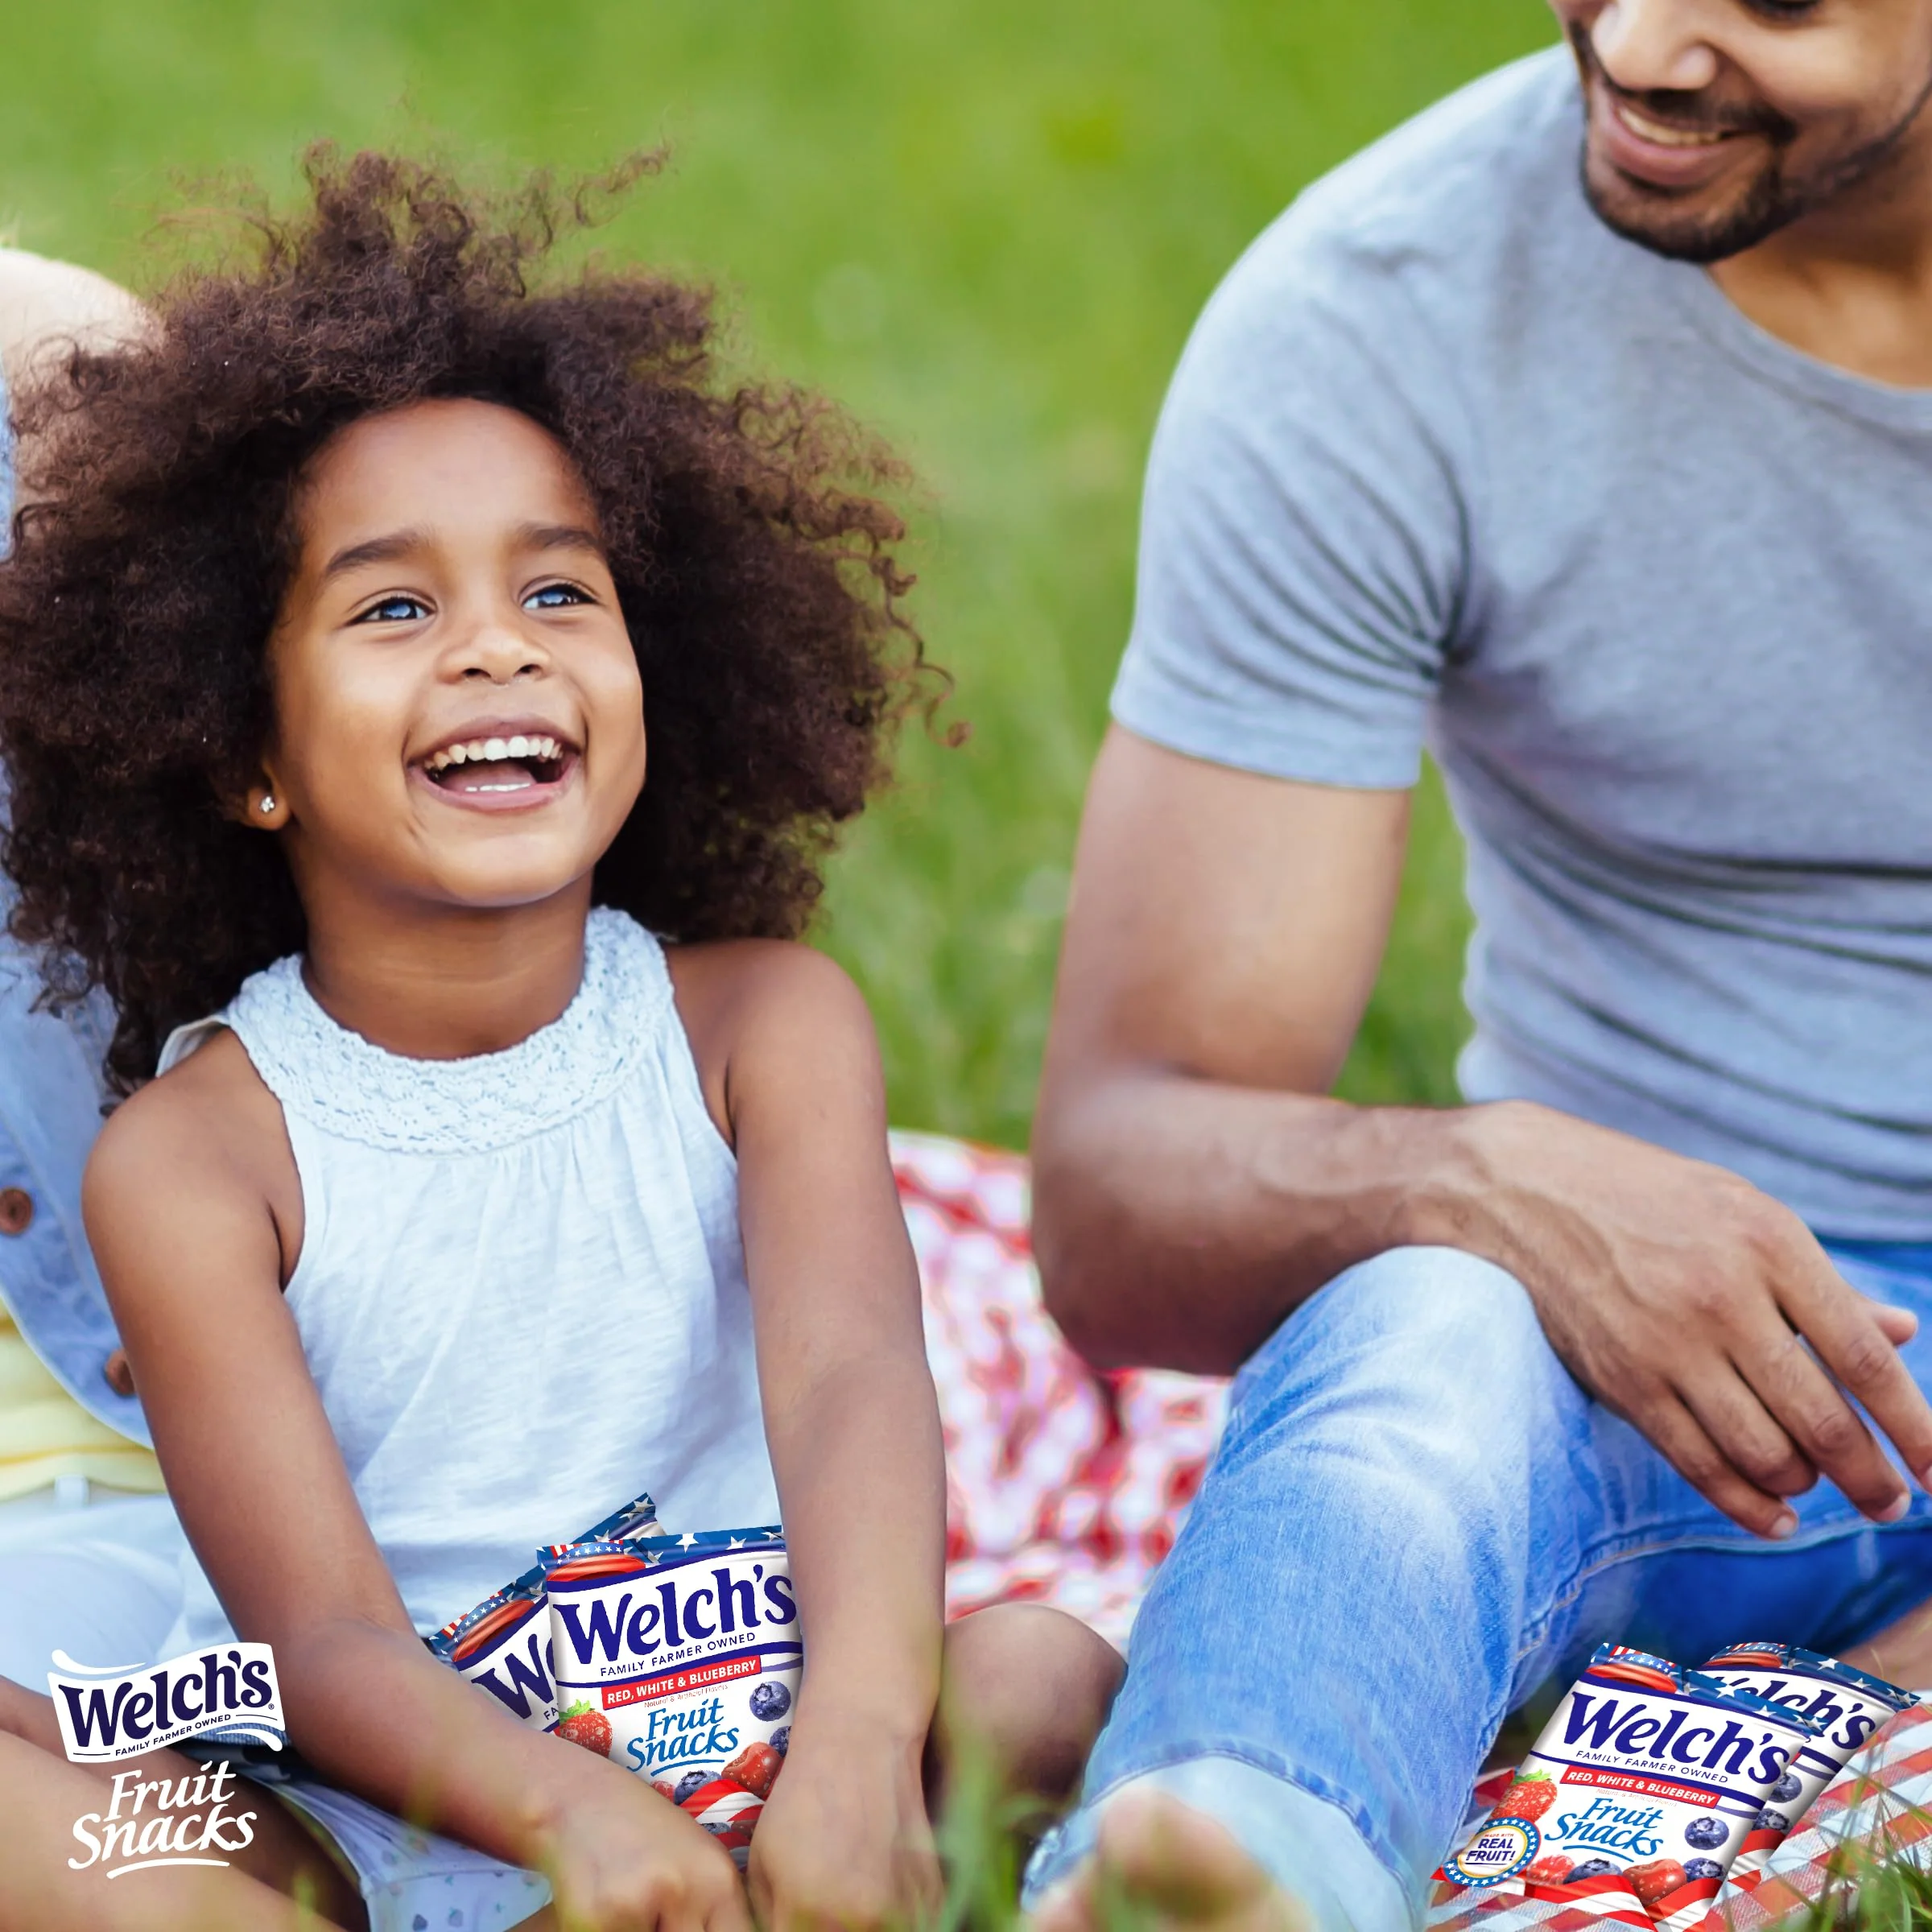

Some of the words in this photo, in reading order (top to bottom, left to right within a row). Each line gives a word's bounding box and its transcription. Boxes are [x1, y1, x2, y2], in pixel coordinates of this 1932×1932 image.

[553, 1564, 797, 1665] Welch's
[471, 1633, 556, 1719] W
[601, 1660, 645, 1677] FAMILY
[651, 1645, 702, 1666] FARMER
[707, 1632, 756, 1651] OWNED
[607, 1689, 634, 1704] RED,
[636, 1678, 675, 1698] WHITE
[677, 1676, 687, 1687] &
[689, 1659, 757, 1685] BLUEBERRY
[543, 1703, 559, 1720] FA
[645, 1697, 724, 1742] Fruit
[626, 1724, 740, 1773] Snacks
[1563, 1690, 1790, 1785] Welch's
[1567, 1771, 1594, 1783] RED,
[1596, 1774, 1635, 1788] WHITE
[1635, 1780, 1645, 1790] &
[1647, 1781, 1716, 1805] BLUEBERRY
[1575, 1750, 1621, 1764] FAMILY
[1624, 1757, 1676, 1773] FARMER
[1680, 1767, 1729, 1784] OWNED
[1544, 1812, 1664, 1856] Snacks
[1578, 1798, 1664, 1829] Fruit
[1465, 1850, 1516, 1862] FRUIT!
[1477, 1838, 1513, 1849] REAL
